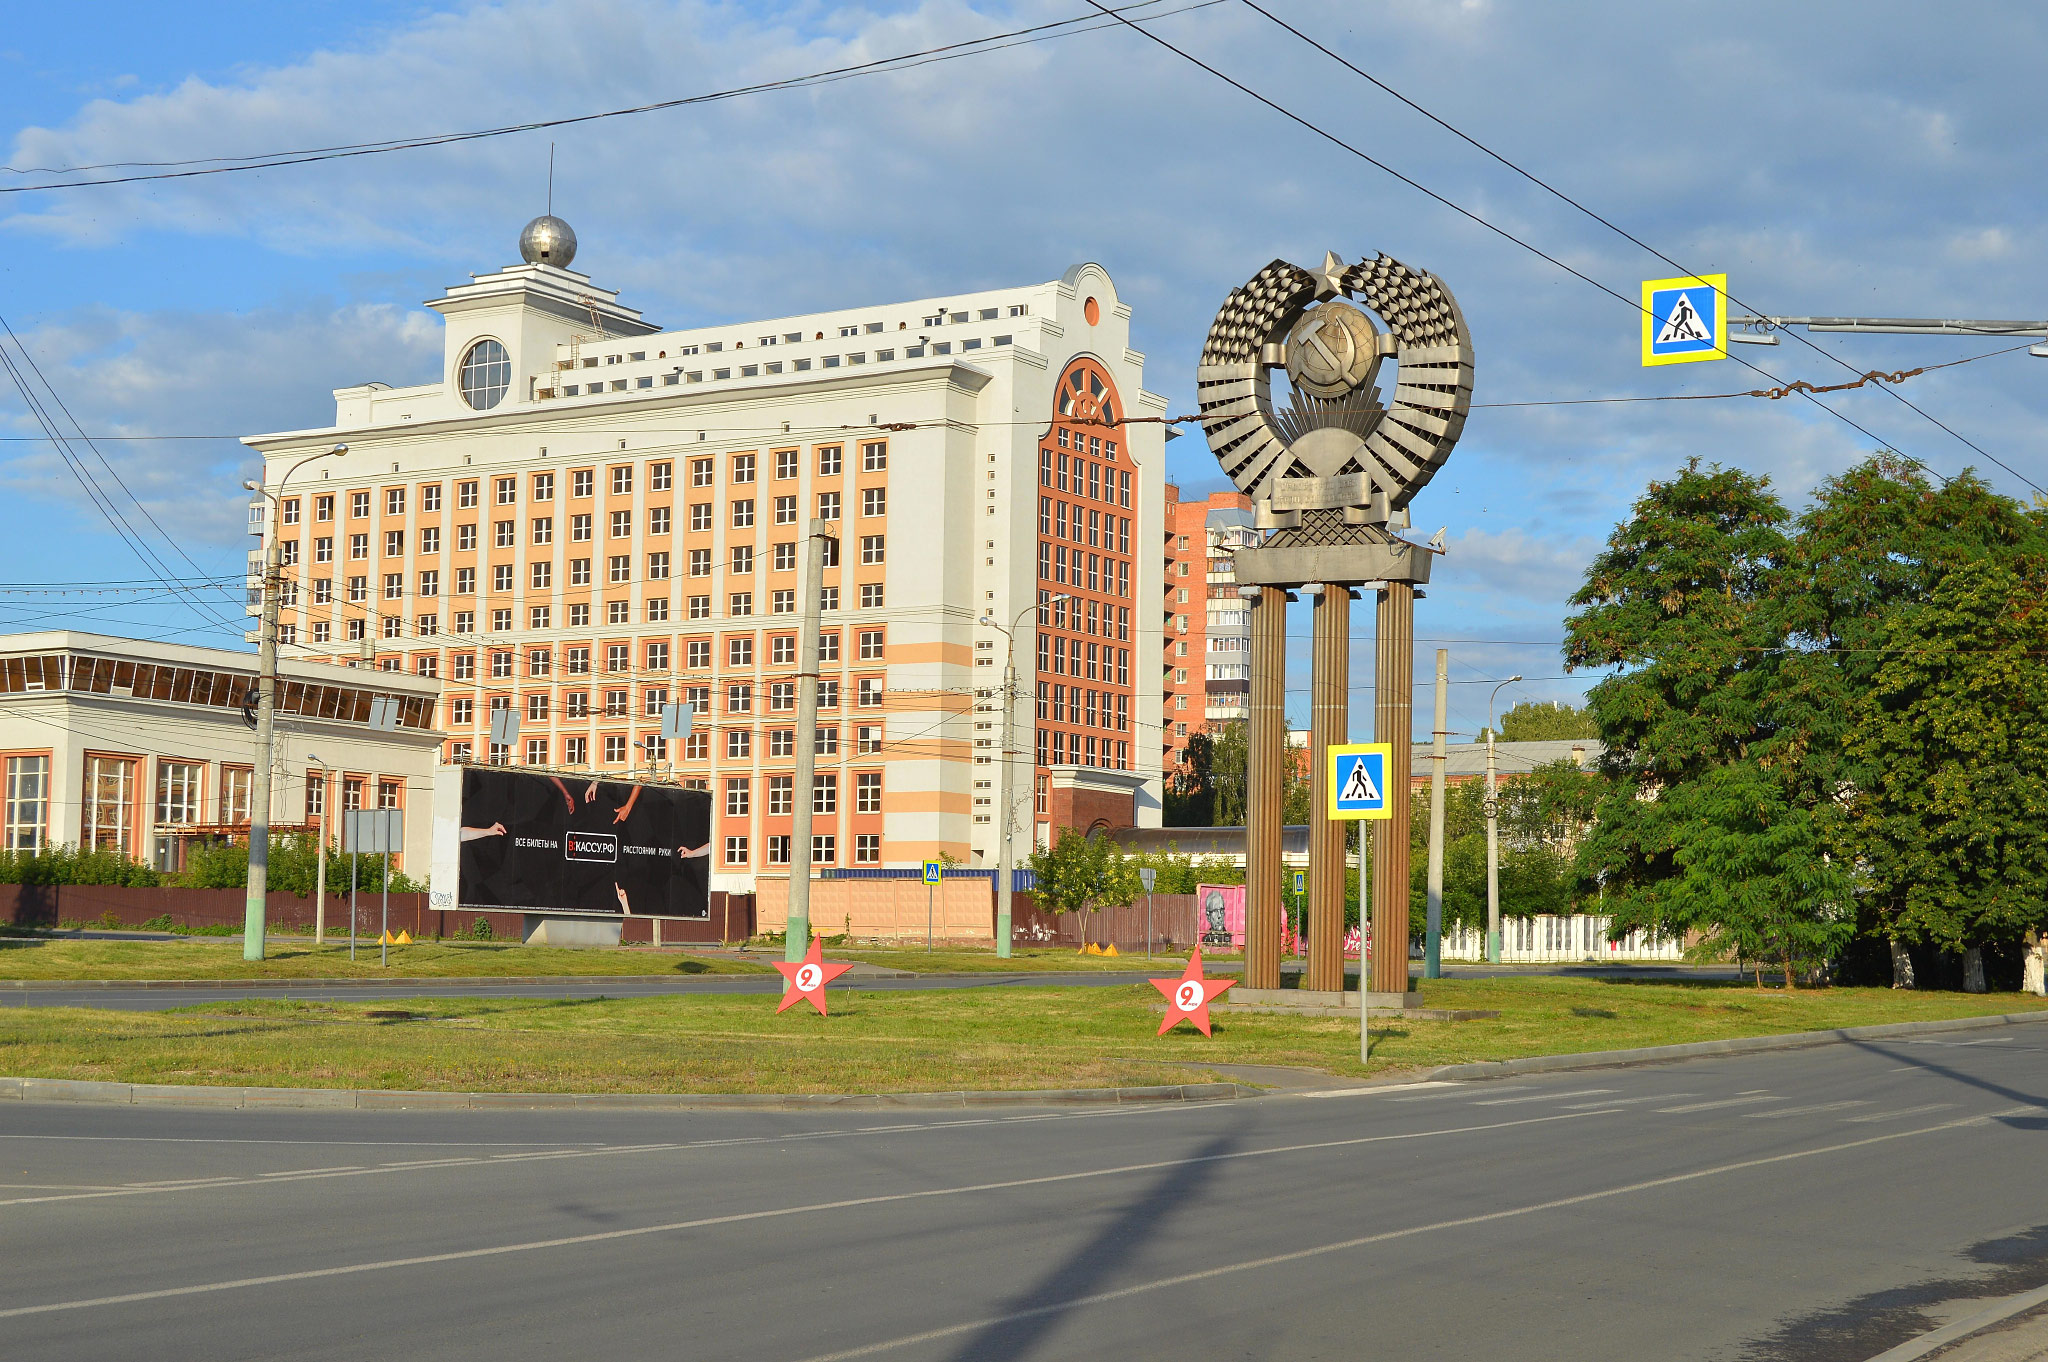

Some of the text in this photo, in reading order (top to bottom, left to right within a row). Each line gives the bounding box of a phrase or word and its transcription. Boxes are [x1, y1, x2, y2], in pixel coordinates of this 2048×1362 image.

[514, 837, 558, 849] ВСЕ БИЛЕТЫ НА
[622, 845, 671, 857] РАССТОЯНИИ РУКИ
[801, 968, 813, 987] 9
[1181, 986, 1194, 1006] 9
